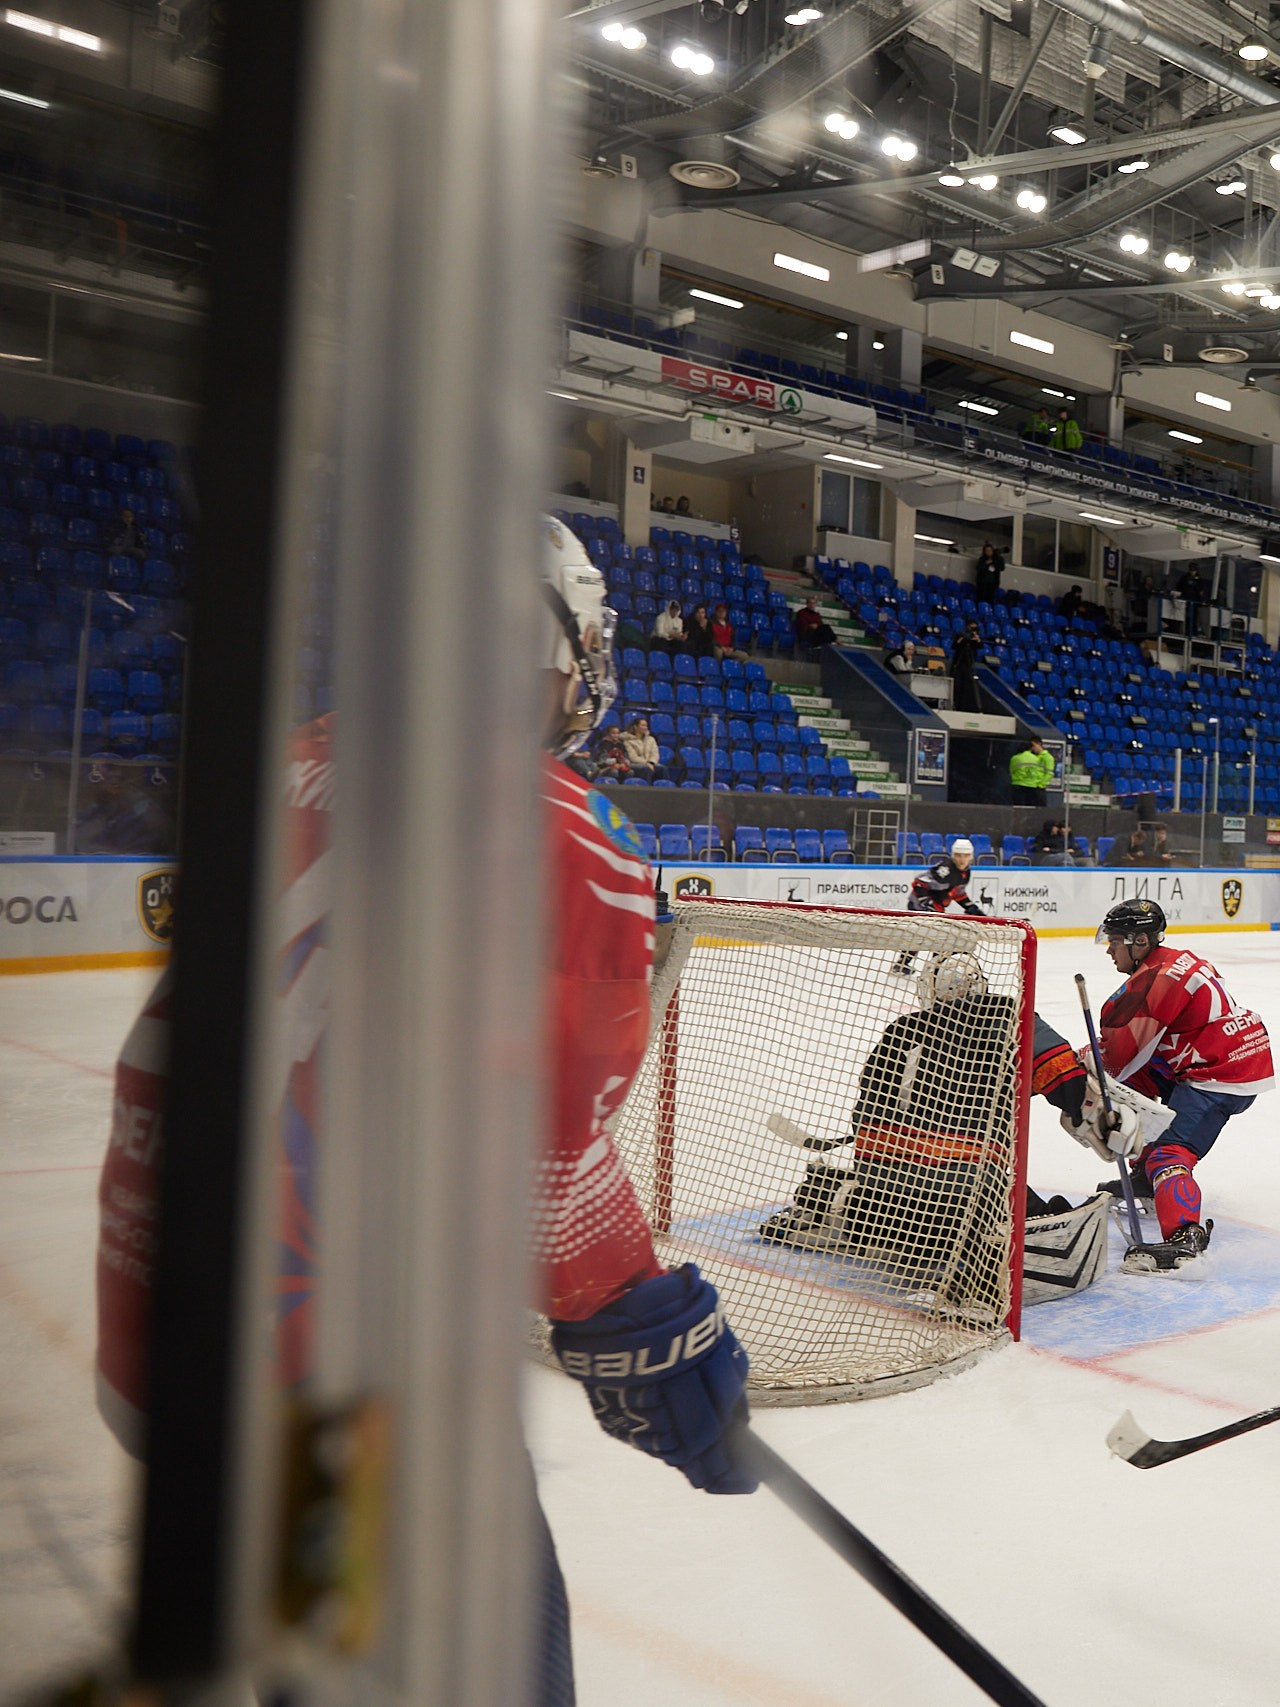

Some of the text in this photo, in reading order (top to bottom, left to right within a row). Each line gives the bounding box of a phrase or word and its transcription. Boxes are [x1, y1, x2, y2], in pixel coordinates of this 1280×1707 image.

[688, 368, 774, 404] SPAR
[1031, 460, 1080, 481] ЧЕМПИОНАТ
[731, 528, 740, 539] 5
[1108, 553, 1116, 569] 9
[816, 883, 909, 895] ПРАВИТЕЛЬСТВО
[1003, 885, 1049, 897] НИЖНИЙ
[1112, 877, 1184, 901] ЛИГА
[0, 895, 78, 925] ОСА
